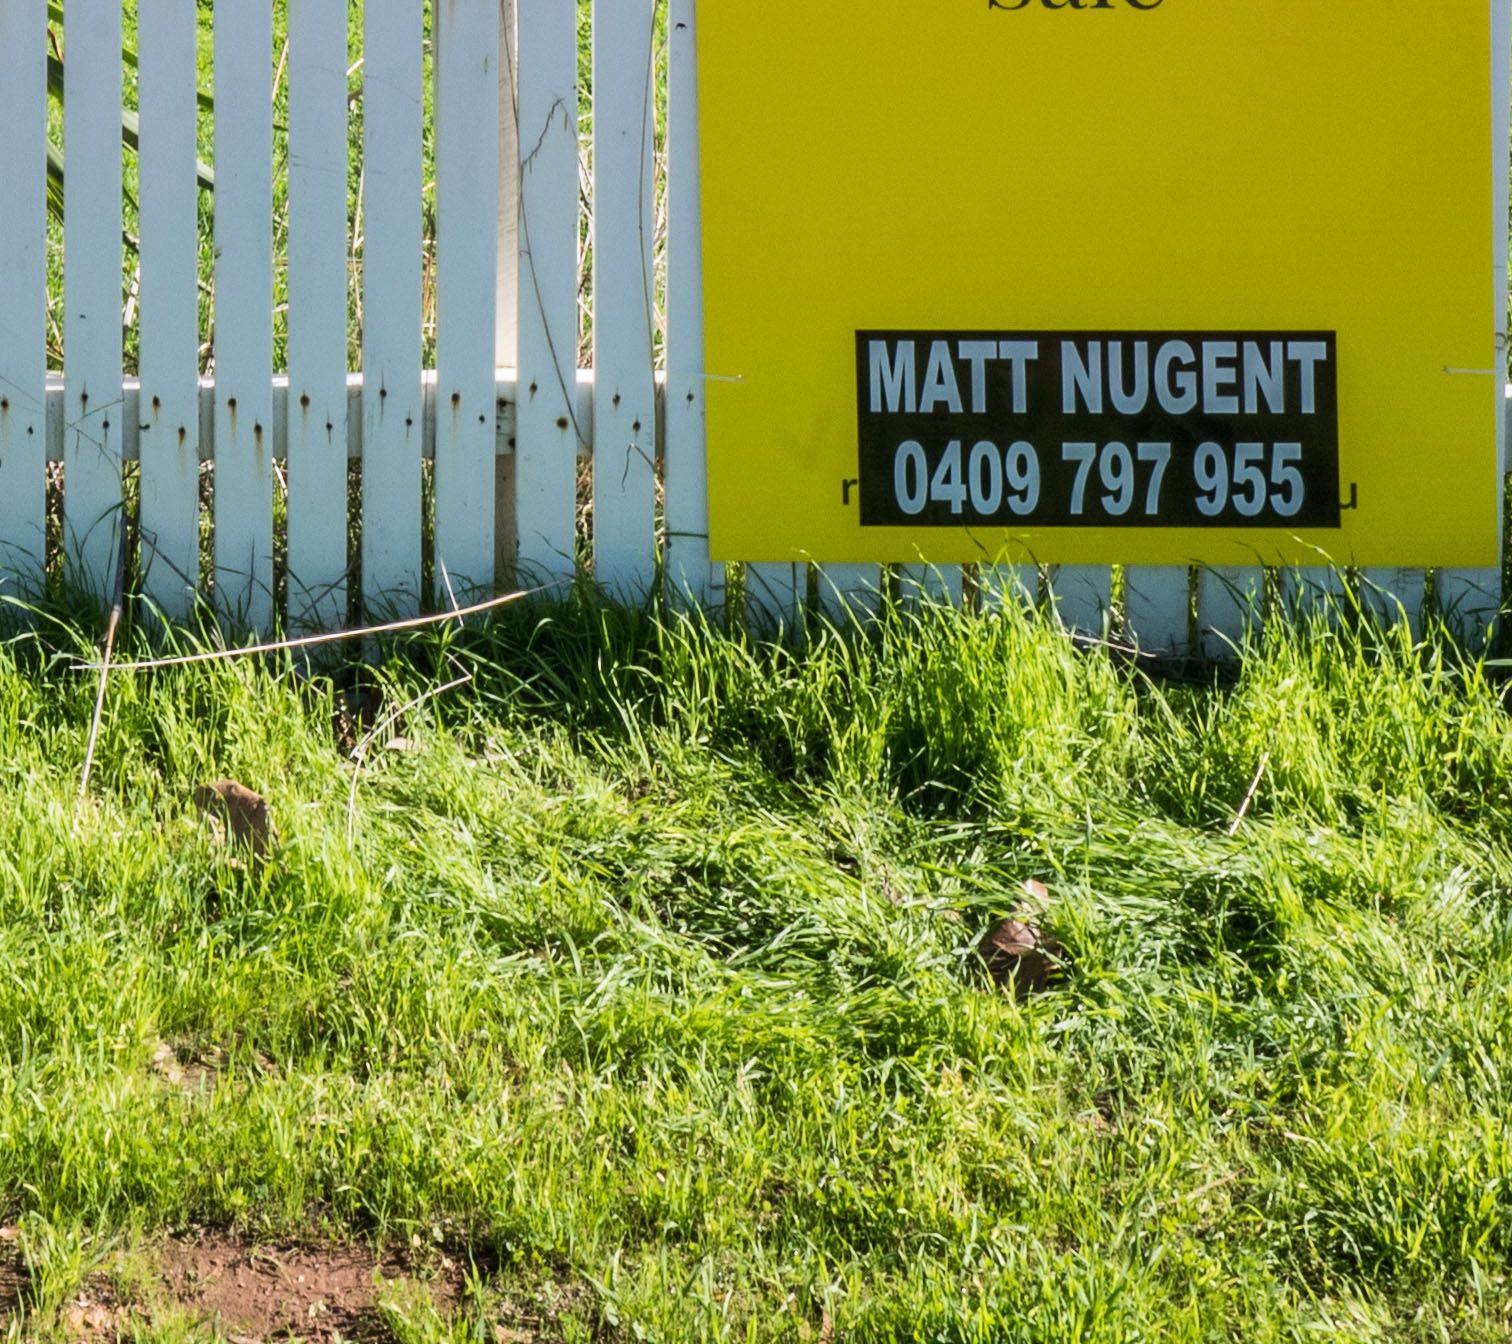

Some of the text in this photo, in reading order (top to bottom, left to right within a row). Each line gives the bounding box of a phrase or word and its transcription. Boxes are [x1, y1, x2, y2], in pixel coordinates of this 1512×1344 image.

[867, 339, 1328, 416] MATT NUGENT
[893, 439, 1306, 518] 0409 797 955
